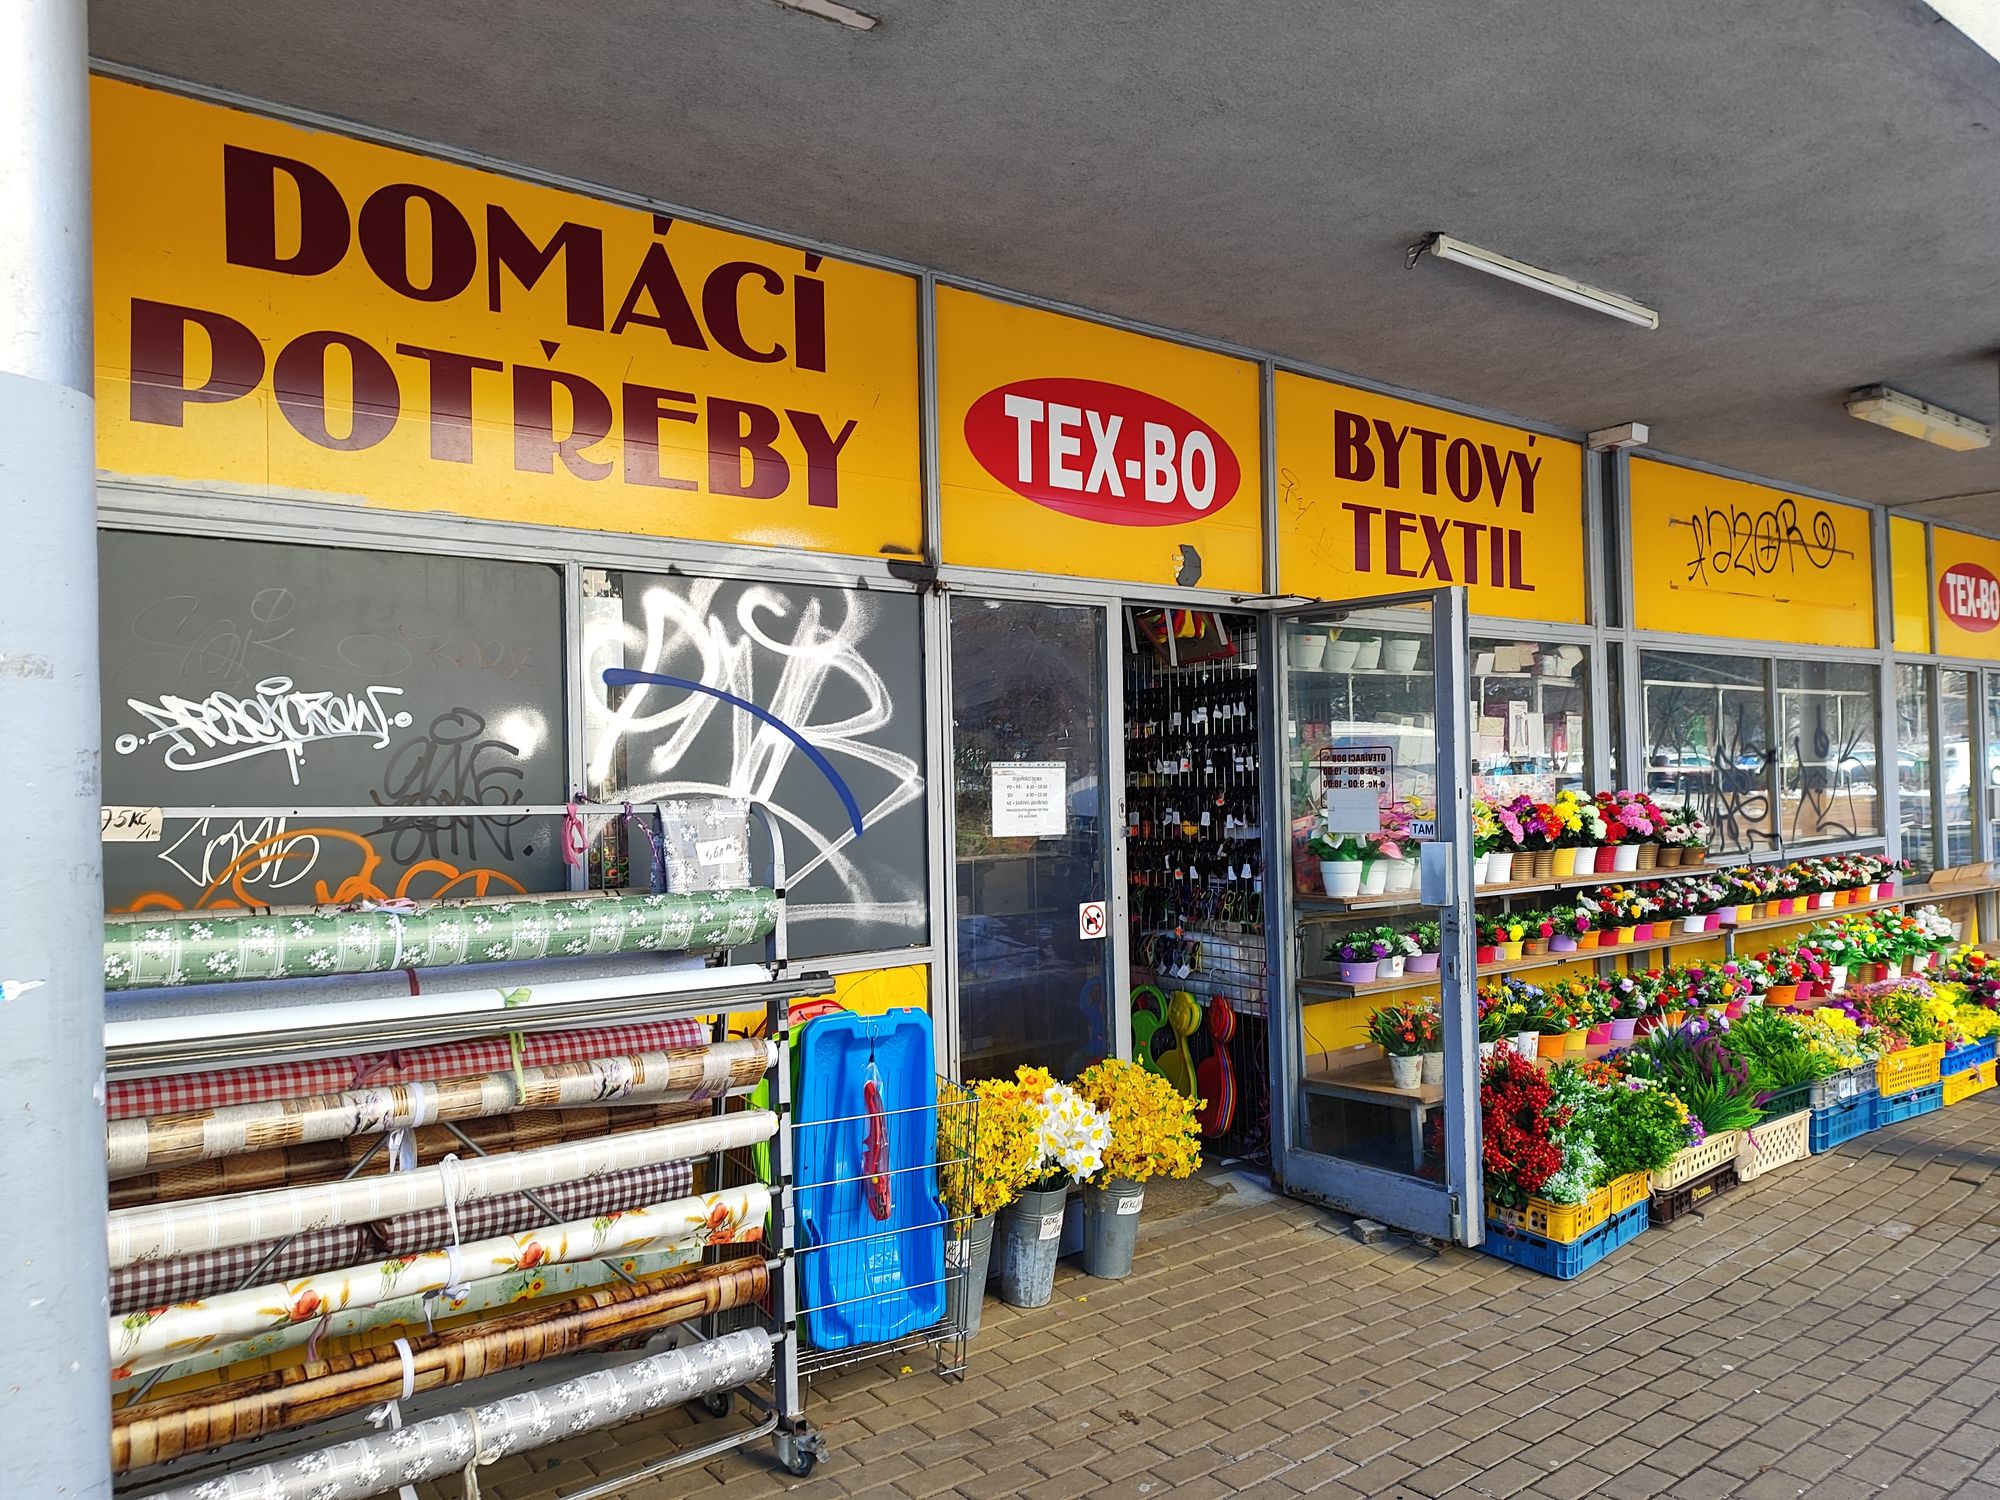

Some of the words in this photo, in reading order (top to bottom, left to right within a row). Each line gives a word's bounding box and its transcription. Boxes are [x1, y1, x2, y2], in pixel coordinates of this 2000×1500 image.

[223, 144, 827, 373] DOMÁCÍ
[129, 297, 859, 510] POTŘEBY
[1004, 394, 1217, 510] TEX-BO
[1333, 409, 1543, 514] BYTOVÝ
[1341, 502, 1536, 592] TEXTIL
[1946, 572, 1999, 621] TEX-BO
[1413, 823, 1434, 835] TAM
